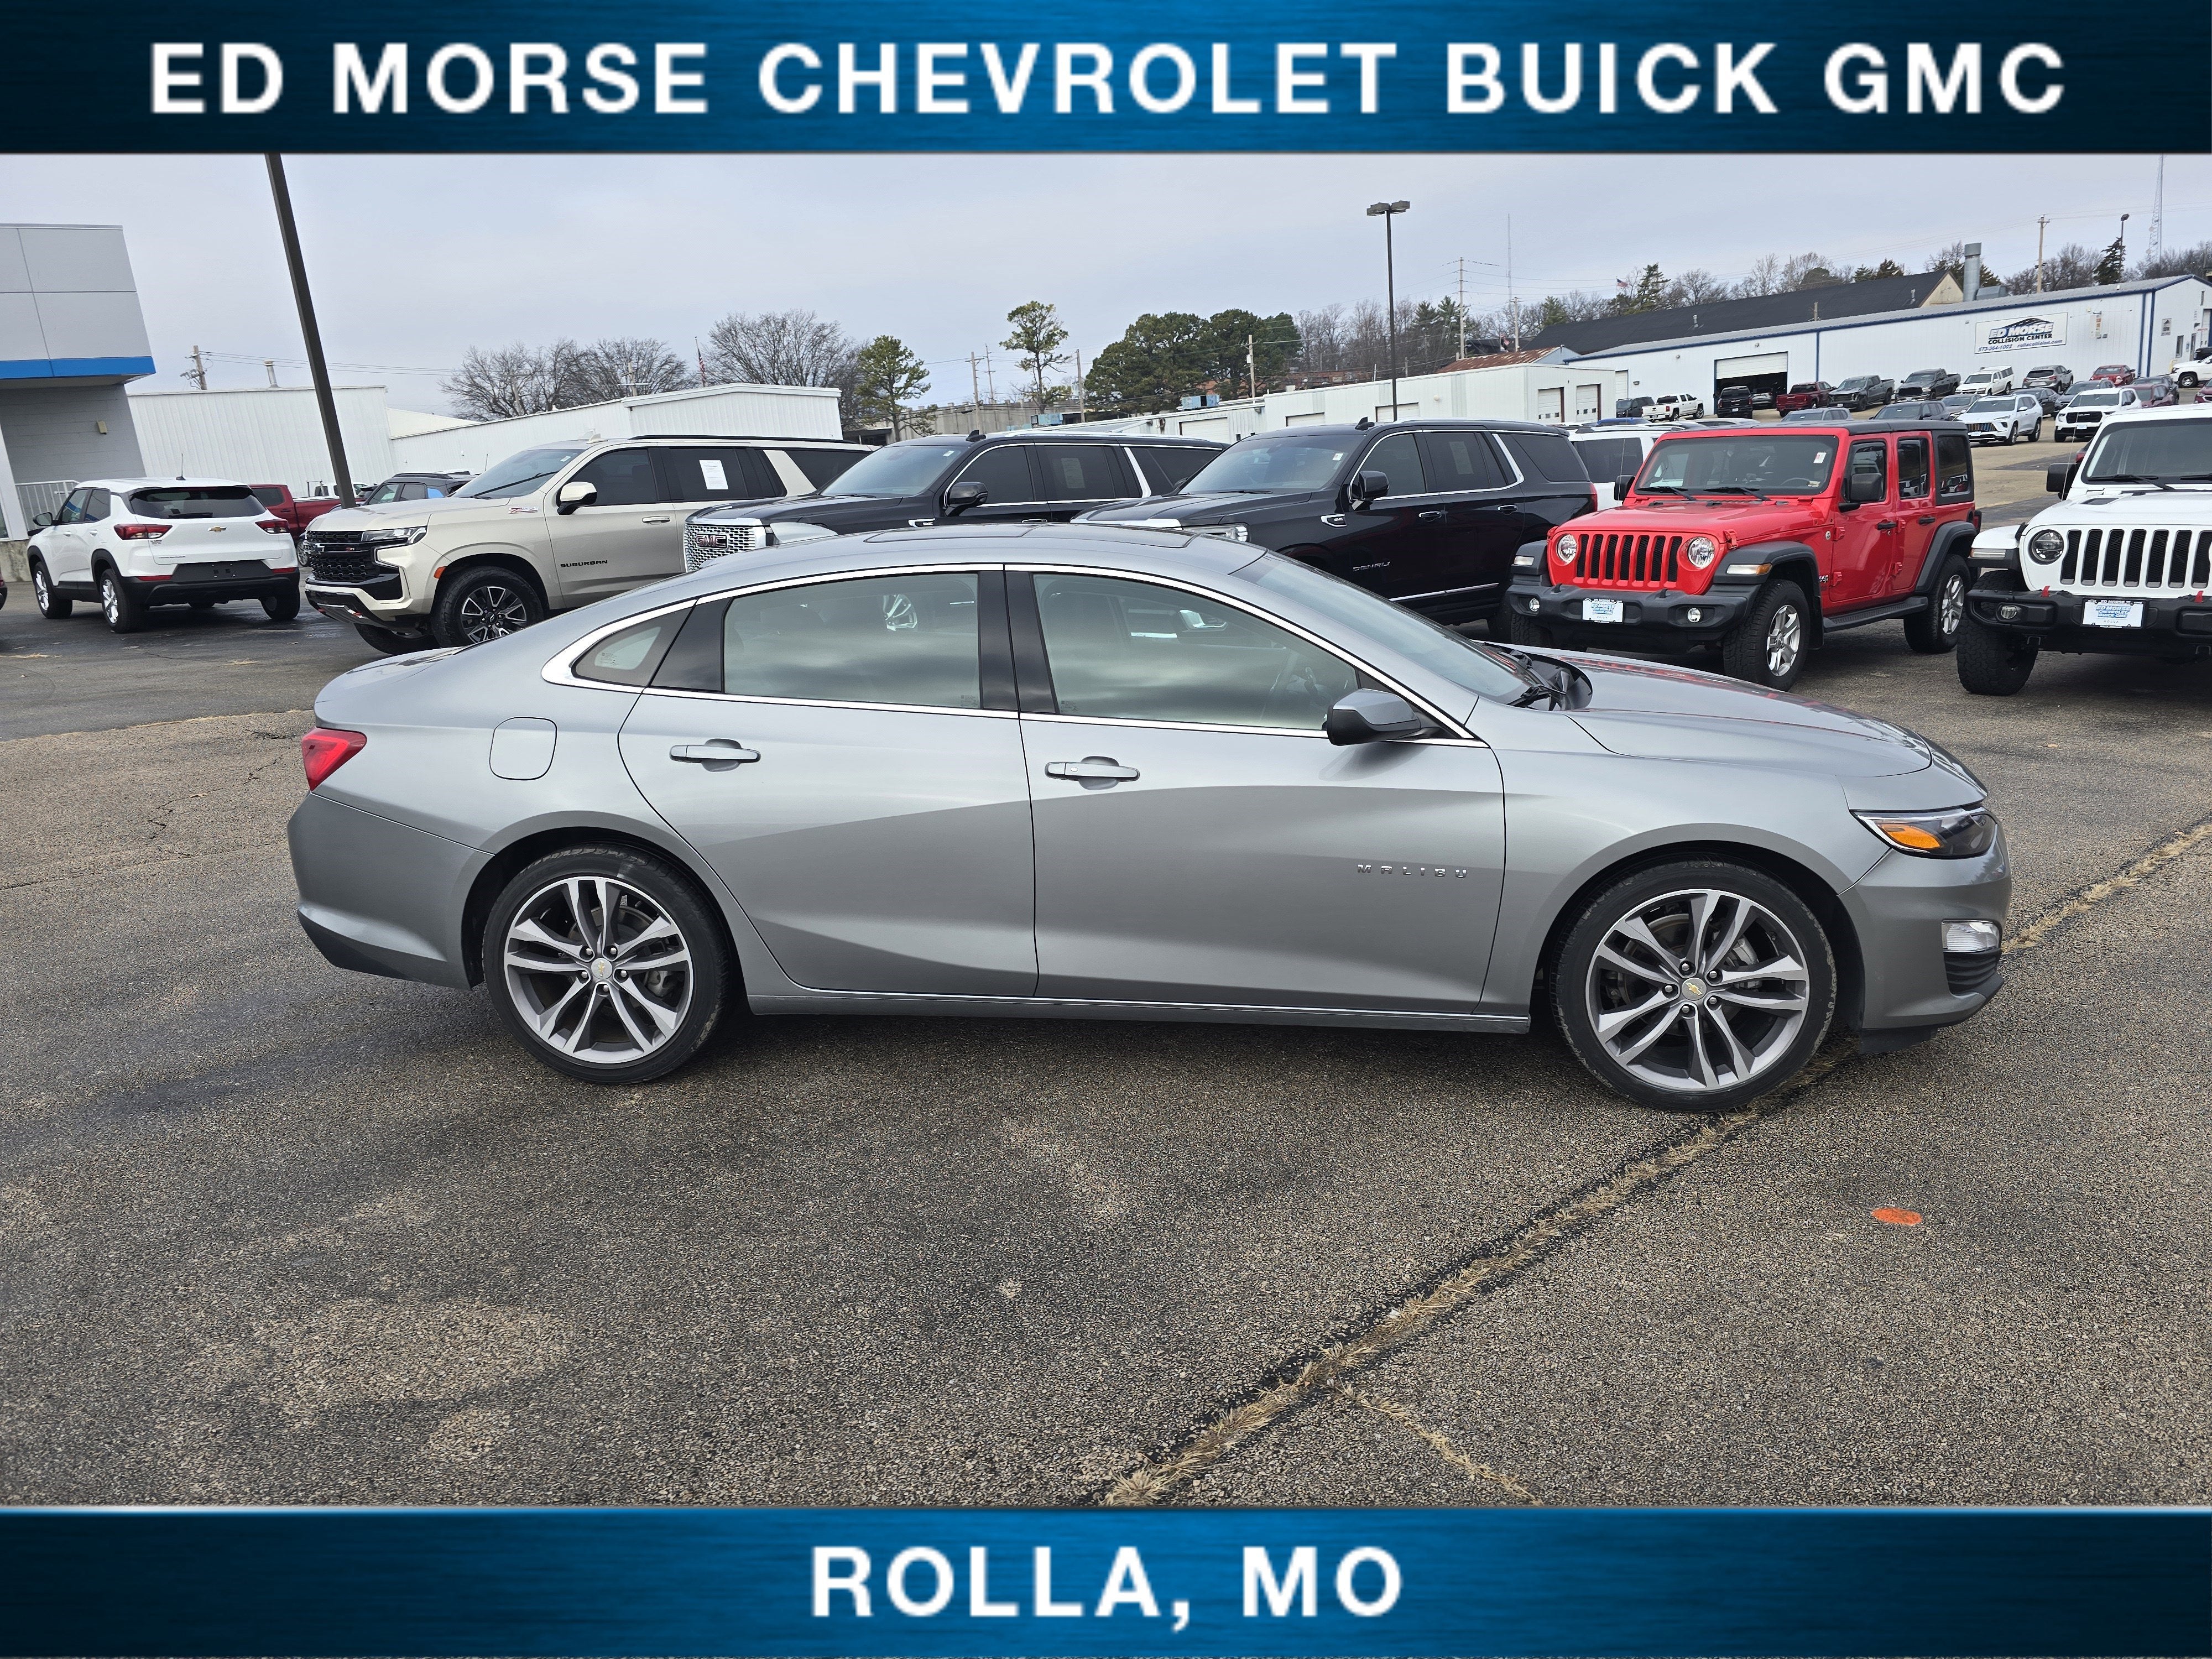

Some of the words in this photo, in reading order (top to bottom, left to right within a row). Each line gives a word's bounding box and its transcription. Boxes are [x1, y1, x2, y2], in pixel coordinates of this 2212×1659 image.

[1989, 328, 2007, 339] ED
[2007, 322, 2054, 337] MORSE
[1988, 336, 2025, 345] COLLISION
[696, 535, 726, 547] GMC
[560, 560, 608, 568] SUBURBAN
[1353, 561, 1390, 571] DENALI
[1358, 864, 1467, 878] MALIBU
